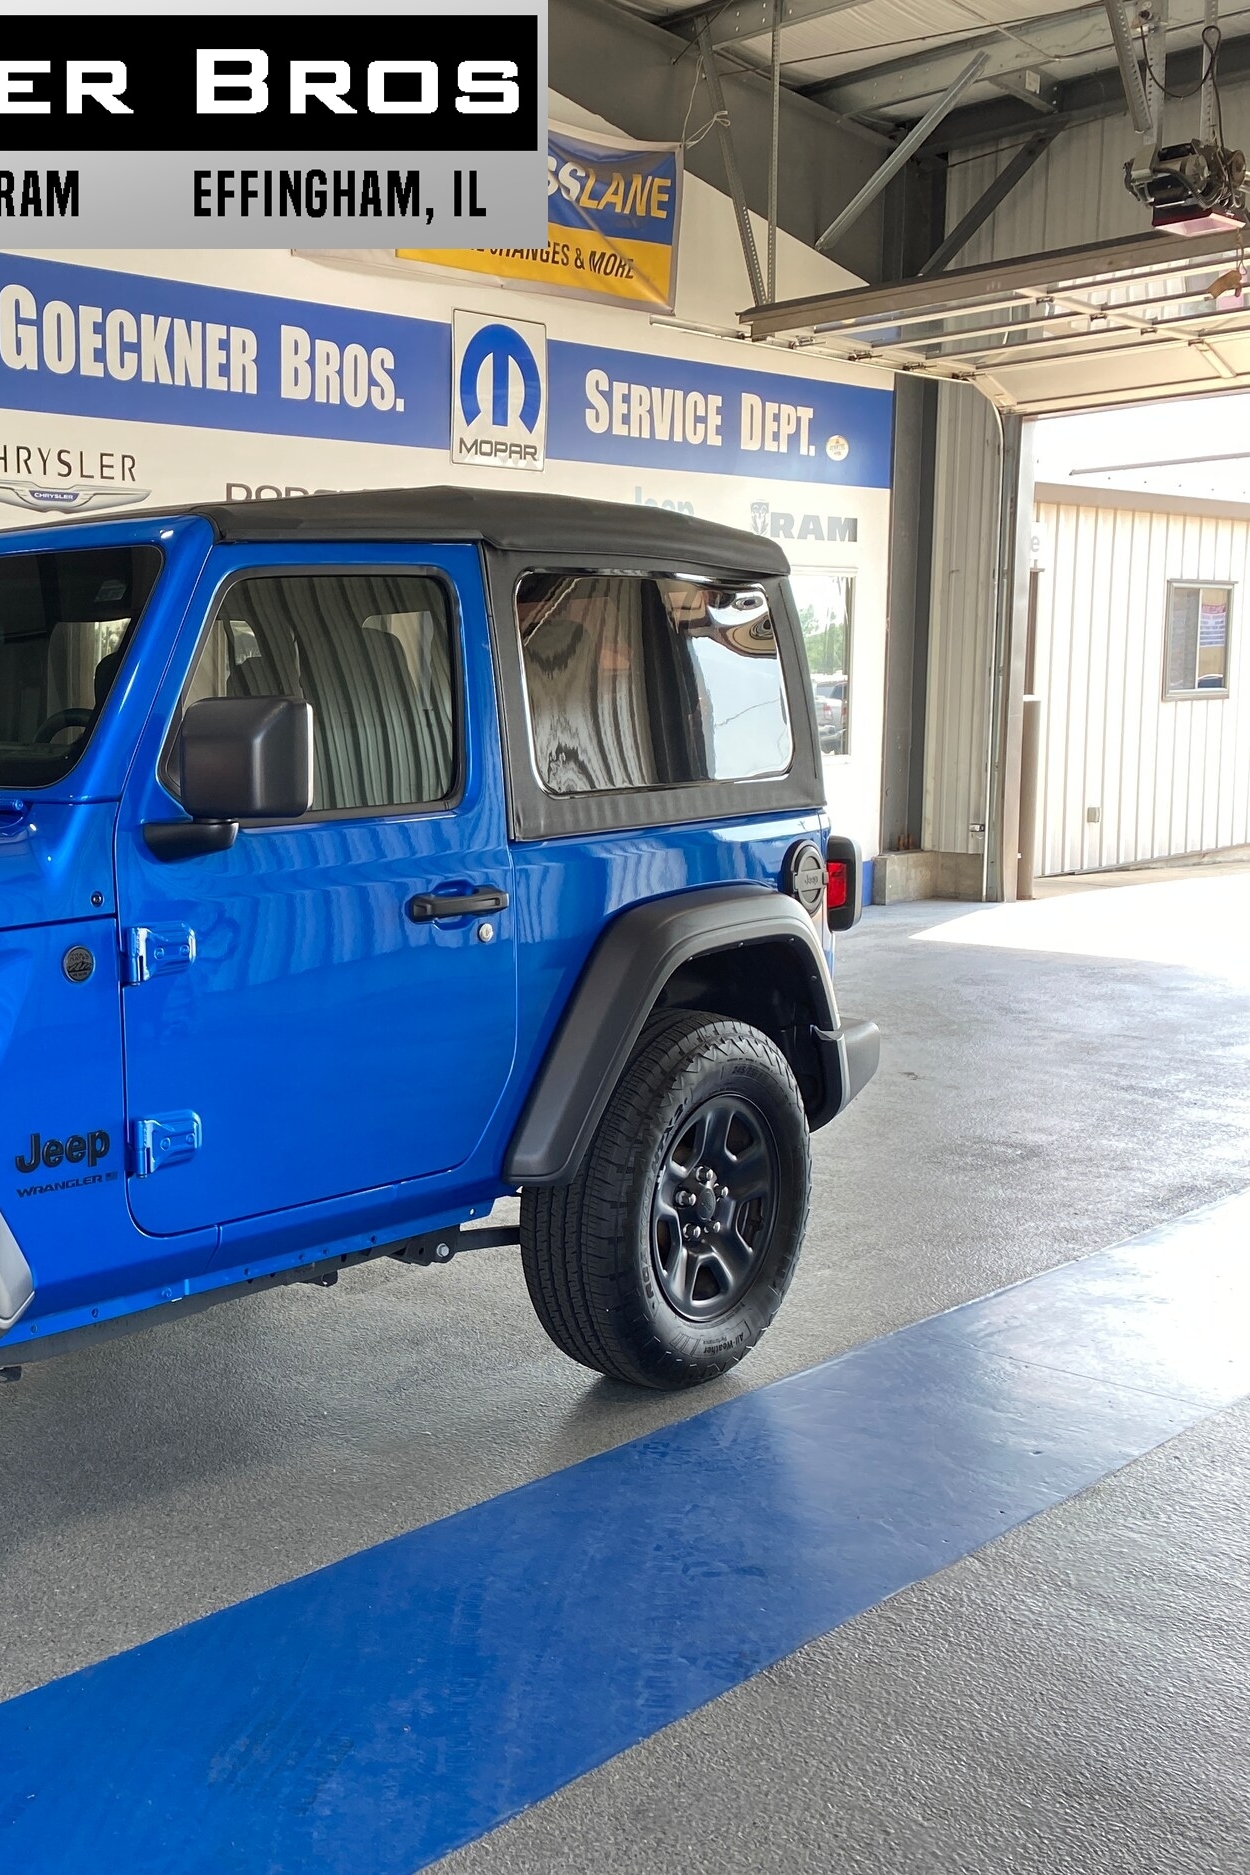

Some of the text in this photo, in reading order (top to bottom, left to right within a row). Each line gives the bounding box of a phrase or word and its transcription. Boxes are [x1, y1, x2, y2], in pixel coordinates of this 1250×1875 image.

[575, 247, 585, 270] &
[588, 250, 634, 280] MORE
[280, 324, 405, 412] BROS.
[585, 368, 816, 457] SERVICE DEPT.
[459, 437, 538, 462] MOPAR
[34, 492, 74, 500] CHRYSLER
[771, 512, 858, 542] RAM
[15, 1130, 110, 1173] Jeep
[16, 1175, 102, 1198] WRANGLER
